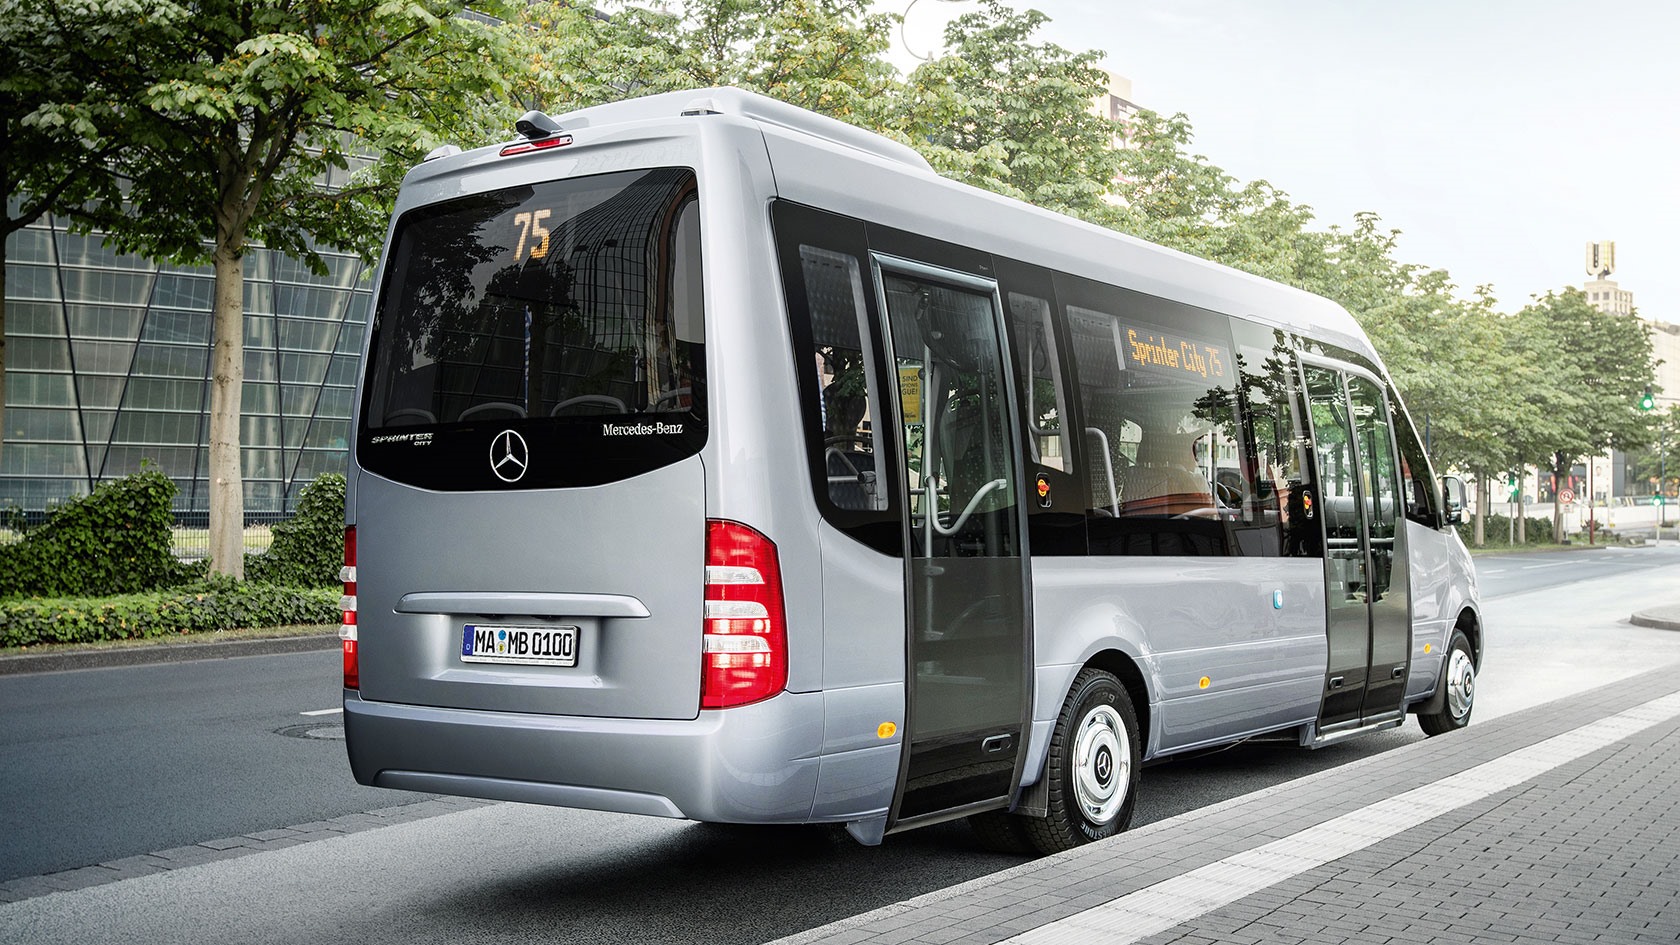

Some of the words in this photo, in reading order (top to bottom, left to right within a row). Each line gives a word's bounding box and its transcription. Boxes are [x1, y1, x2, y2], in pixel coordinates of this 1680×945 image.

[514, 209, 551, 261] 75
[1128, 329, 1179, 368] Sprinter
[1180, 341, 1207, 378] City
[1205, 346, 1224, 377] 75
[371, 433, 434, 444] SPRINTER
[603, 422, 683, 436] Mercedes-Benz
[474, 630, 496, 653] MA
[508, 631, 529, 655] MB
[532, 632, 573, 656] 0100
